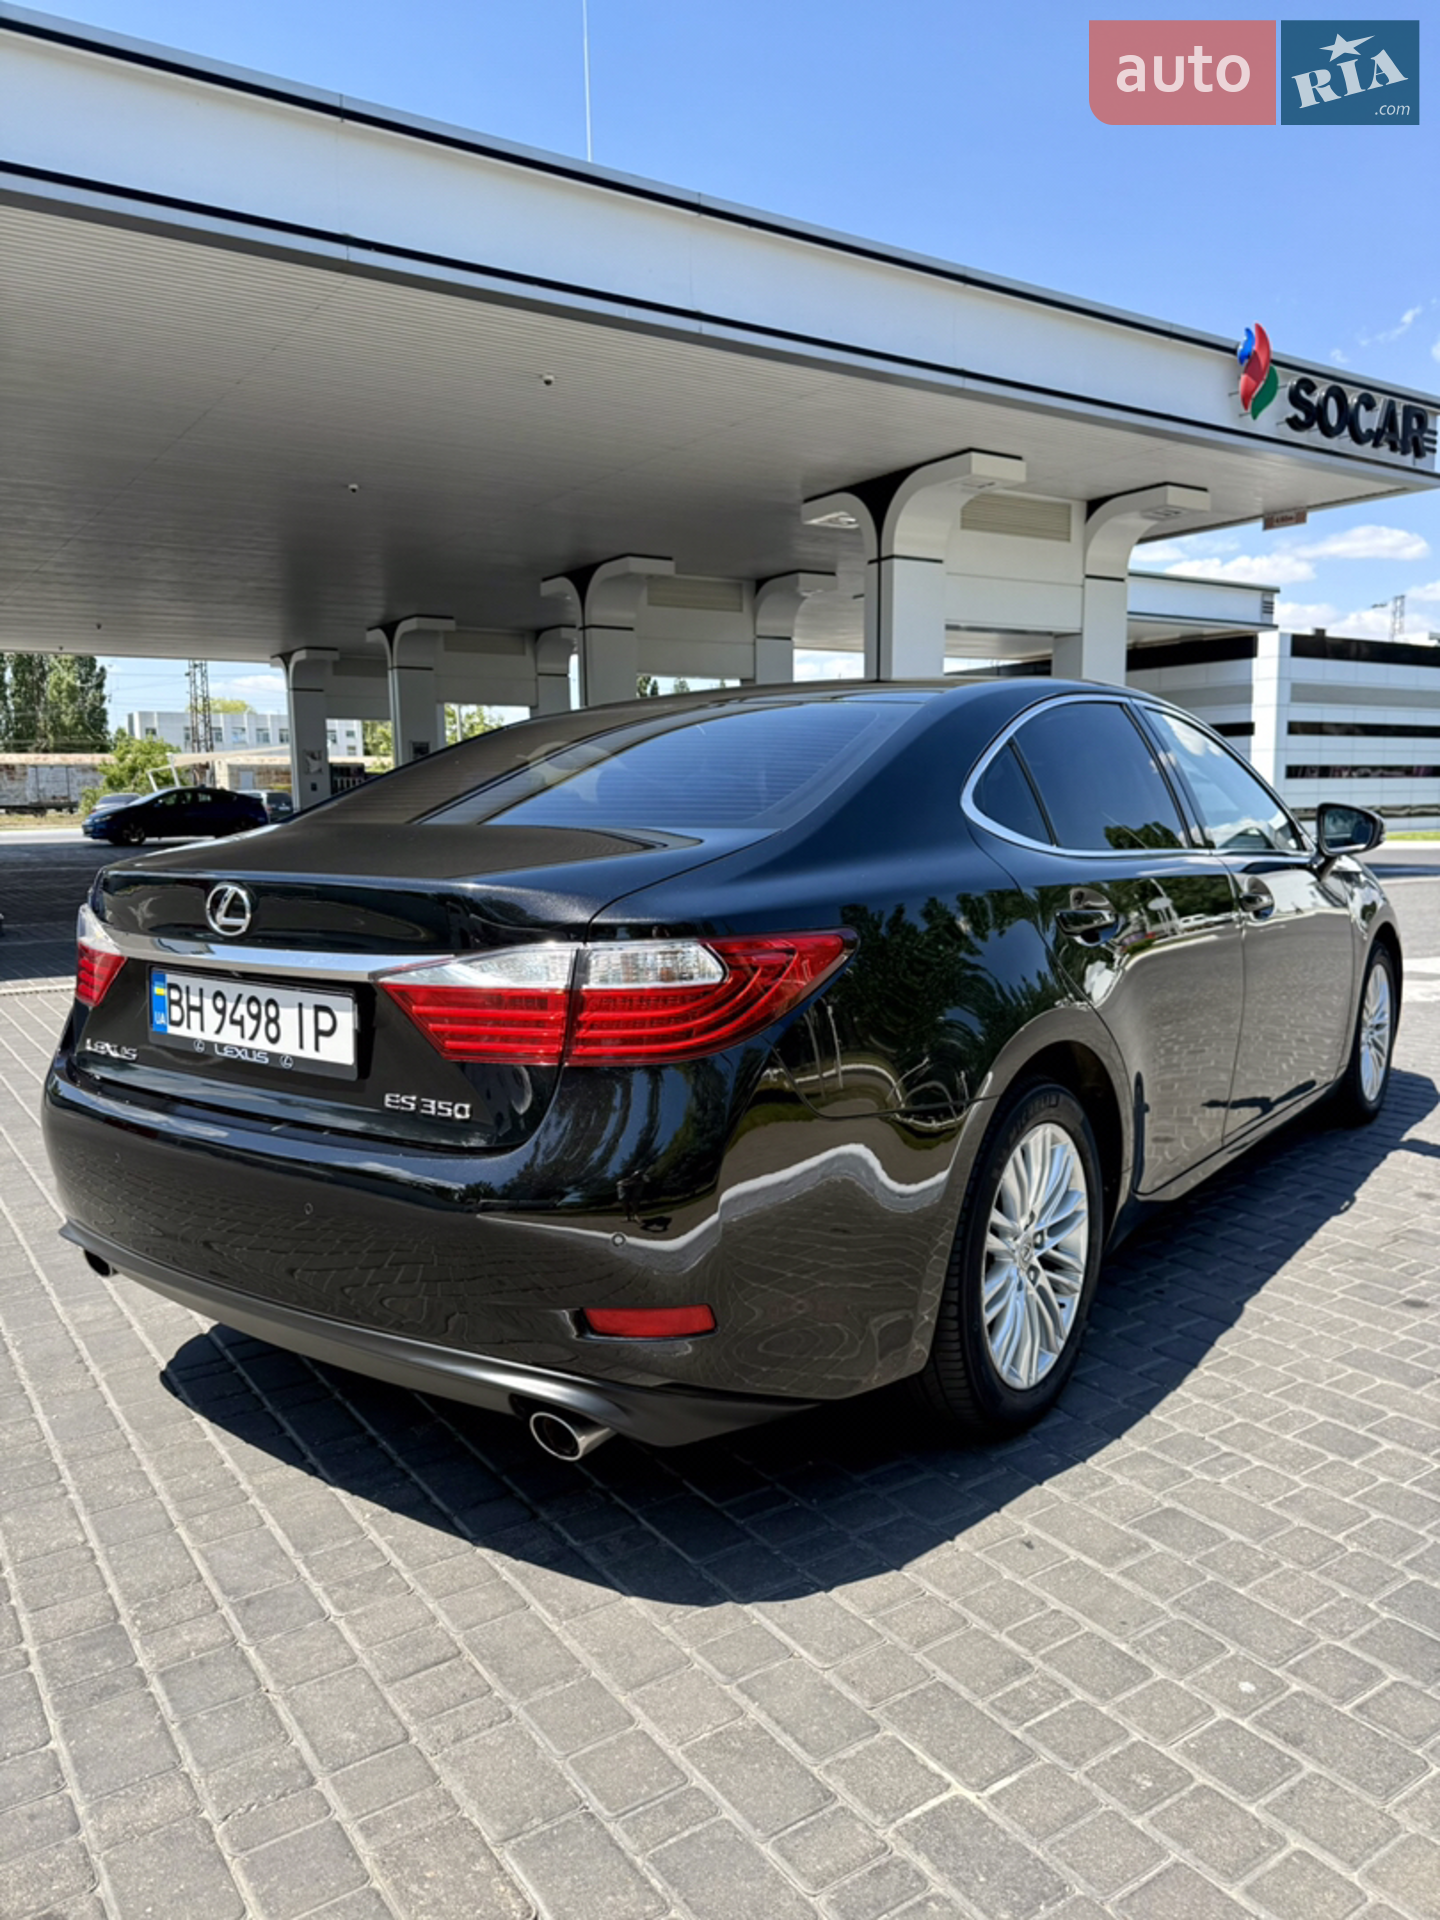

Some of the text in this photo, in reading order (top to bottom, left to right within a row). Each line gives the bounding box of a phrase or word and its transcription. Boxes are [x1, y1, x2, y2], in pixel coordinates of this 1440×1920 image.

[1285, 377, 1429, 458] SOCAR
[155, 1012, 166, 1025] UA
[167, 983, 337, 1052] BH 9498 IP
[85, 1038, 138, 1060] LEXUS
[214, 1044, 269, 1064] LEXUS
[384, 1092, 471, 1119] ES 350
